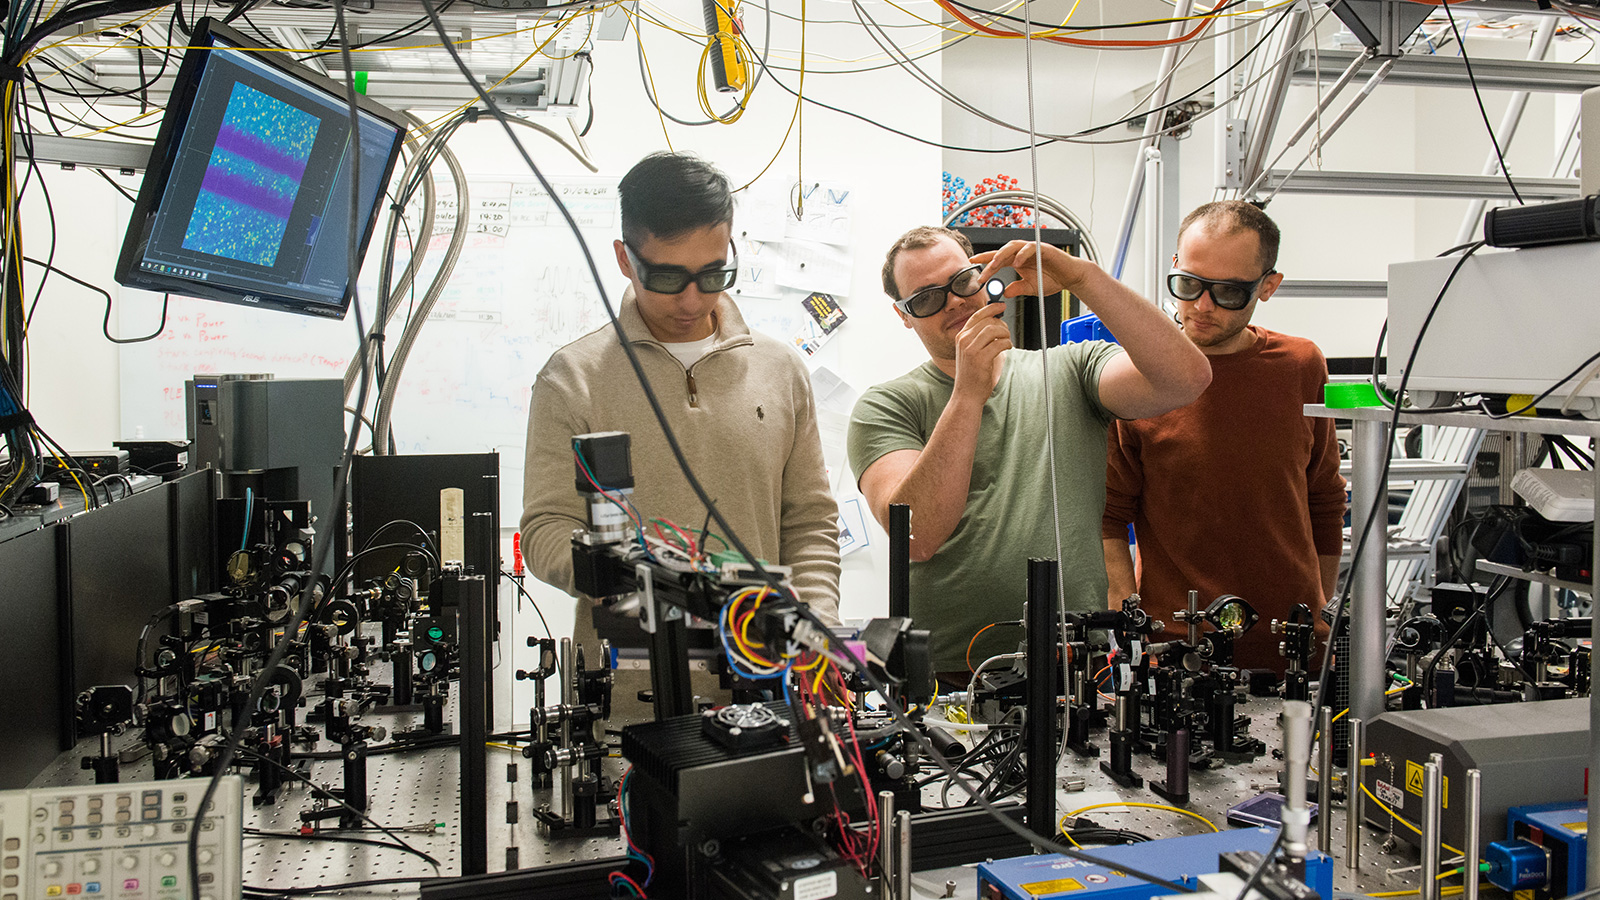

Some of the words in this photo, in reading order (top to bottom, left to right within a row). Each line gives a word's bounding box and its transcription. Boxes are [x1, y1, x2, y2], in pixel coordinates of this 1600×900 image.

[242, 294, 261, 304] ASUS
[196, 312, 225, 328] Power
[198, 329, 229, 343] Power
